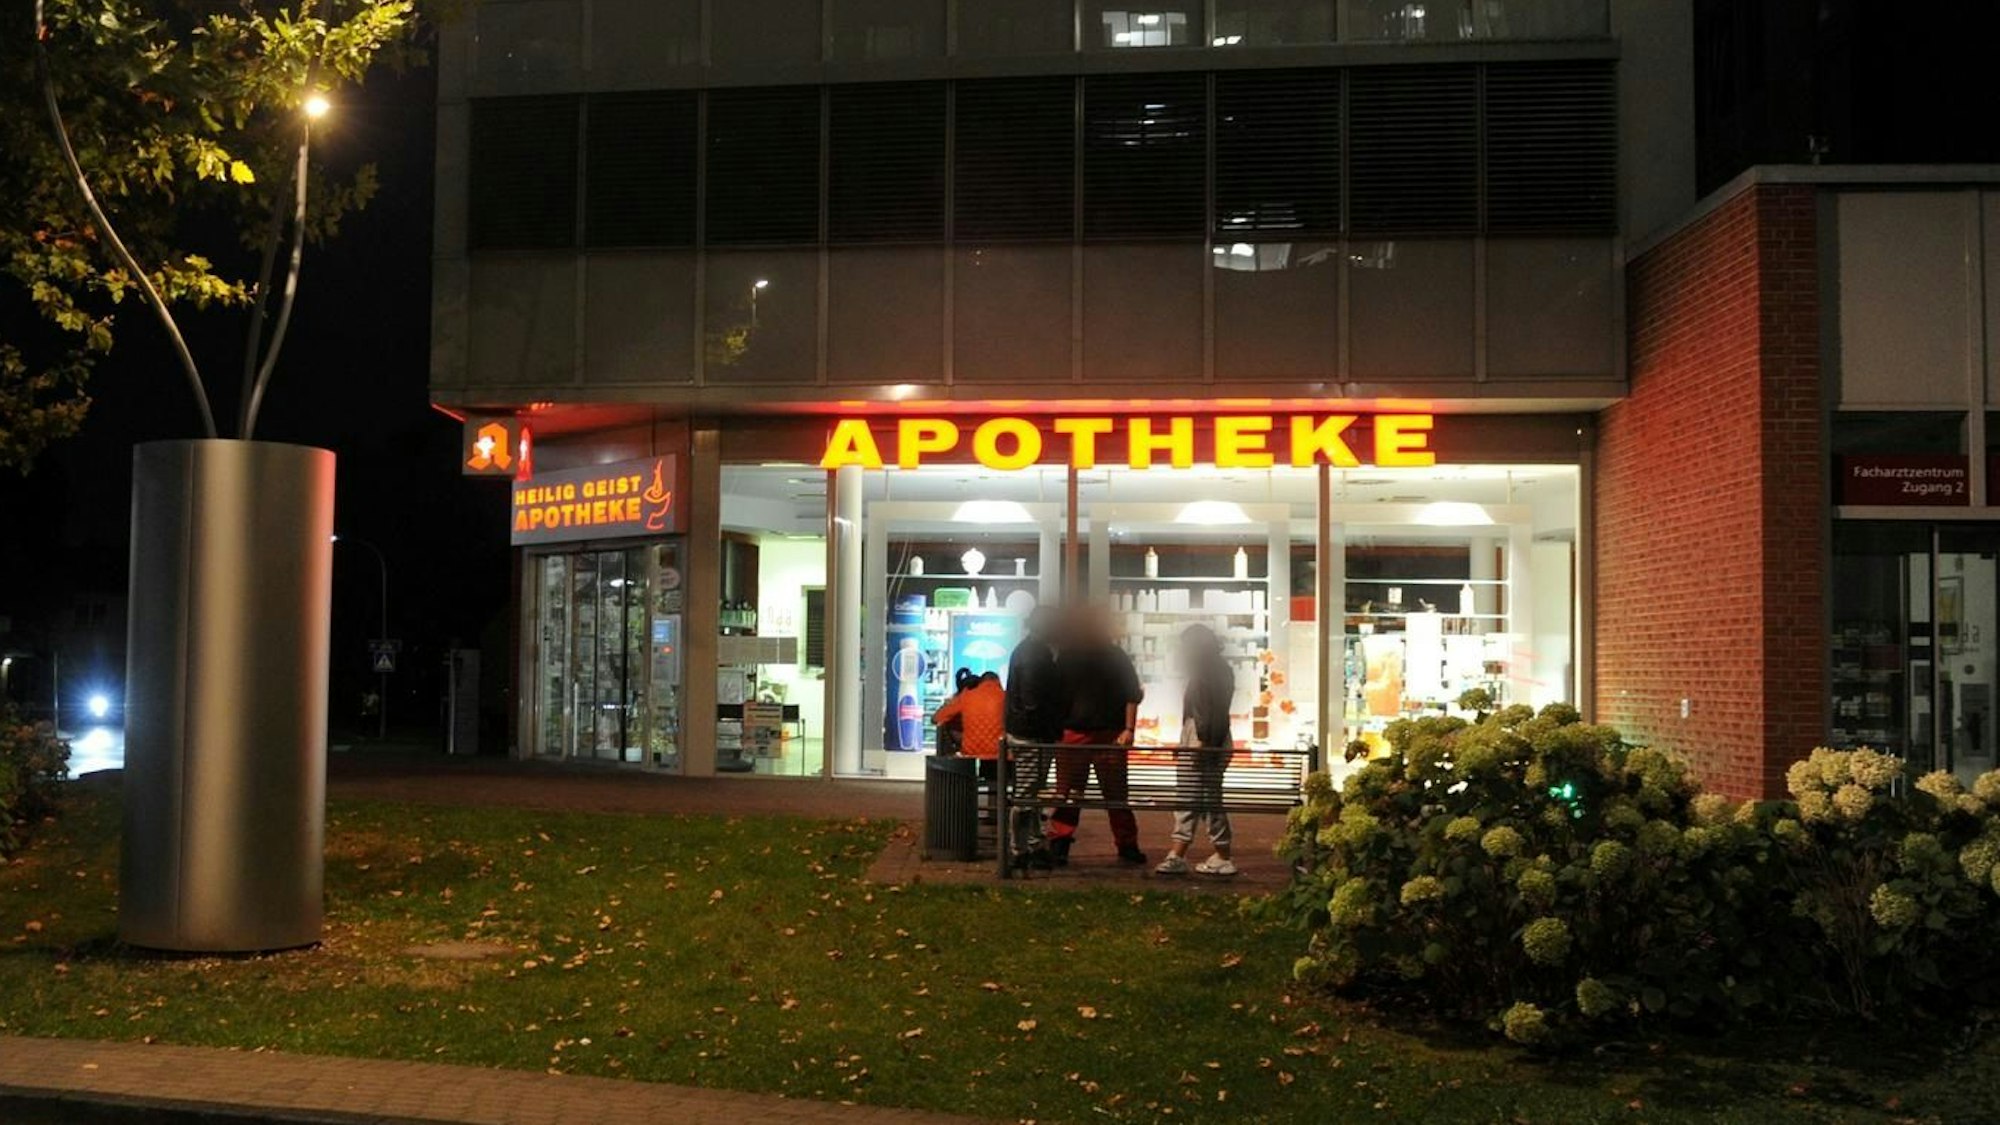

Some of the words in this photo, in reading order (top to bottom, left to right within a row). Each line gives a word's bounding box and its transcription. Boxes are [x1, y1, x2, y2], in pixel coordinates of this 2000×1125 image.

[821, 414, 1436, 471] APOTHEKE
[1853, 466, 1964, 478] Facharztzentrum
[515, 484, 575, 505] HEILIG
[582, 475, 642, 497] GEIST
[1902, 481, 1953, 496] Zugang
[1955, 481, 1964, 493] 2
[514, 497, 642, 531] APOTHEKE
